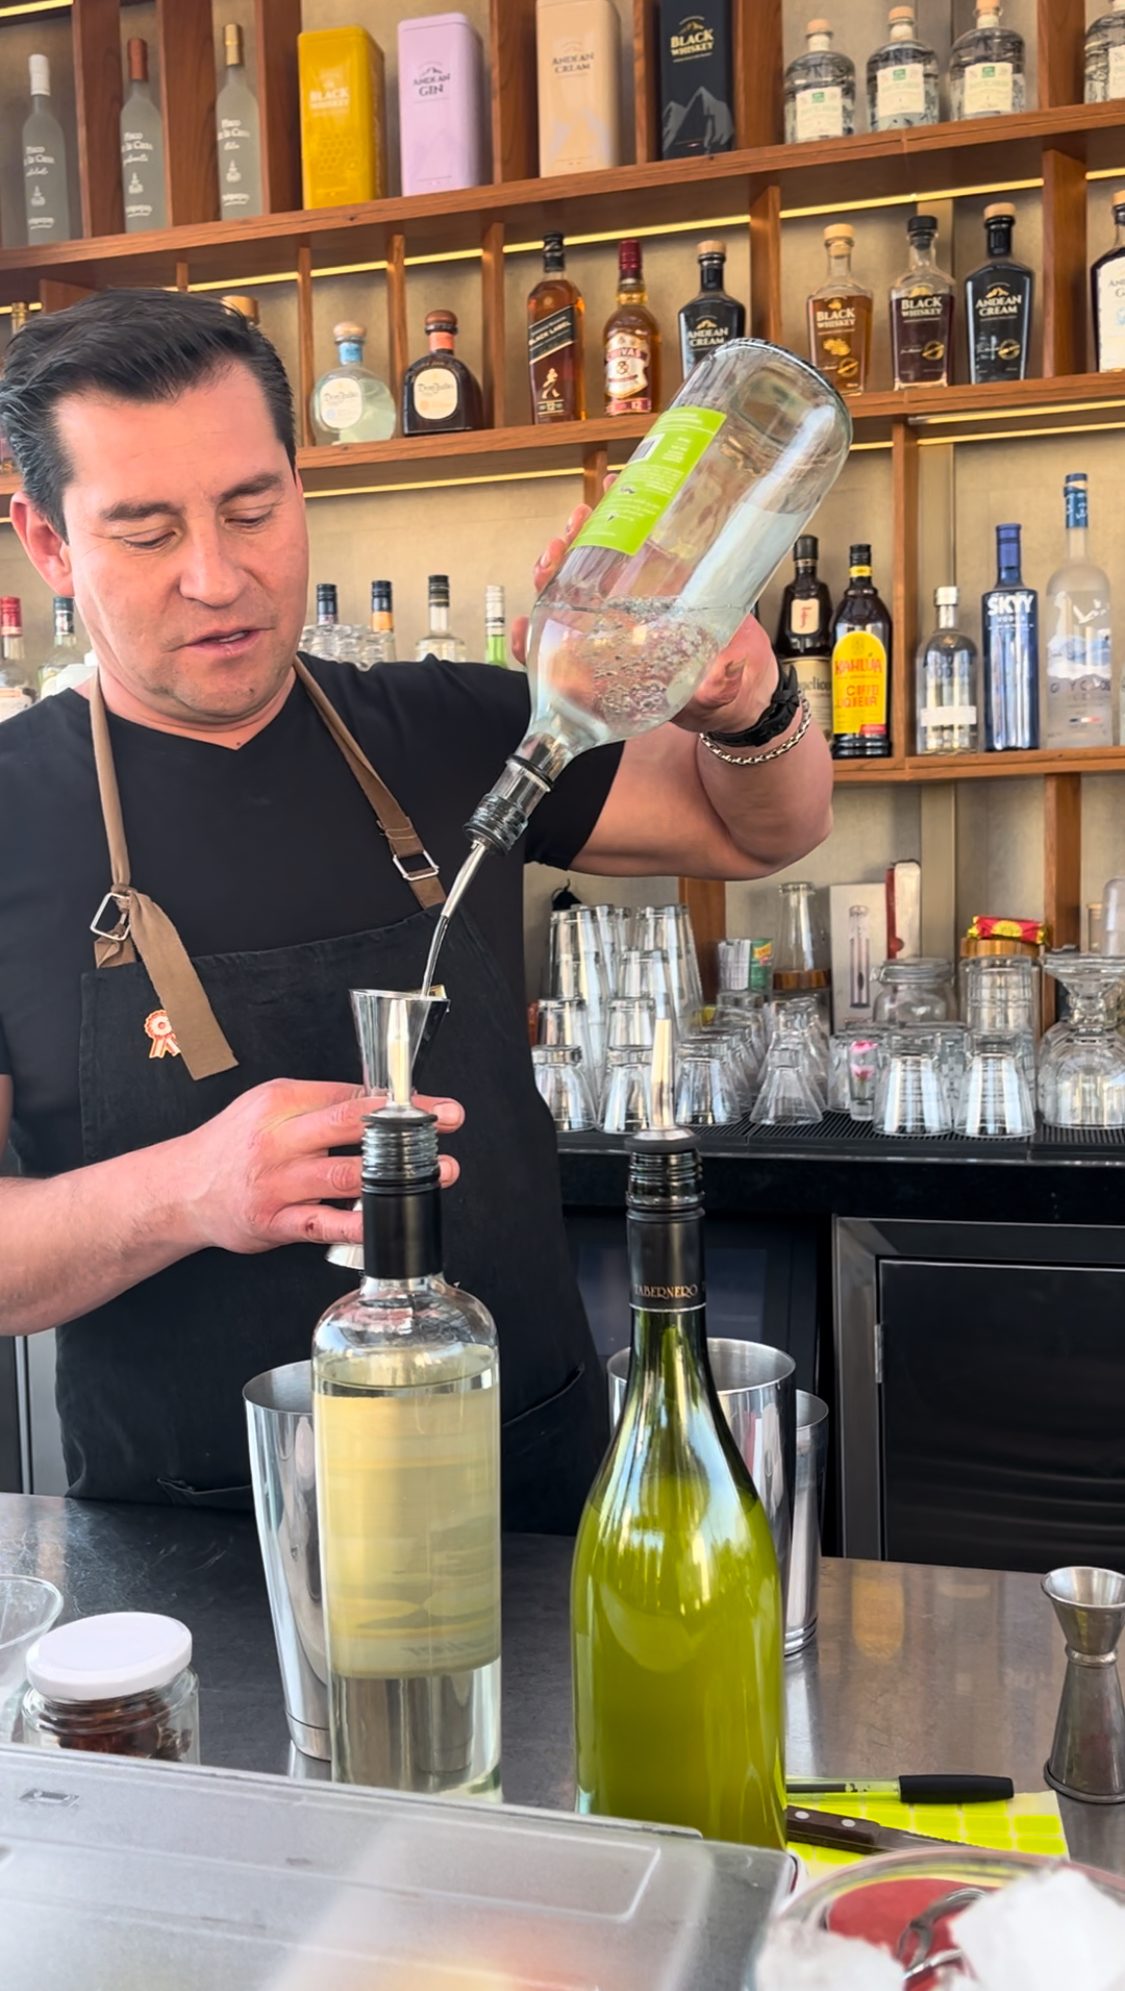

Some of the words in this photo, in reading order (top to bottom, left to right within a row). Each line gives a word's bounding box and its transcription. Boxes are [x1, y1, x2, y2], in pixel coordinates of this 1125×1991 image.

[671, 29, 714, 48] BLACK
[671, 41, 714, 56] WHISKEY
[552, 51, 594, 65] ANDEAN
[554, 63, 591, 73] CREAM
[413, 73, 451, 86] ANDEAN
[309, 87, 349, 102] BLACK
[418, 84, 443, 97] GIN
[901, 296, 943, 310] BLACK
[975, 294, 1022, 308] ANDEAN
[816, 307, 856, 322] BLACK
[901, 307, 943, 317] WHISKEY
[979, 306, 1018, 317] CREAM
[816, 318, 856, 329] WHISKEY
[687, 326, 729, 339] ANDEAN
[689, 336, 725, 348] CREAM
[987, 594, 1034, 616] SKYY
[633, 1283, 699, 1300] TABERNERO
